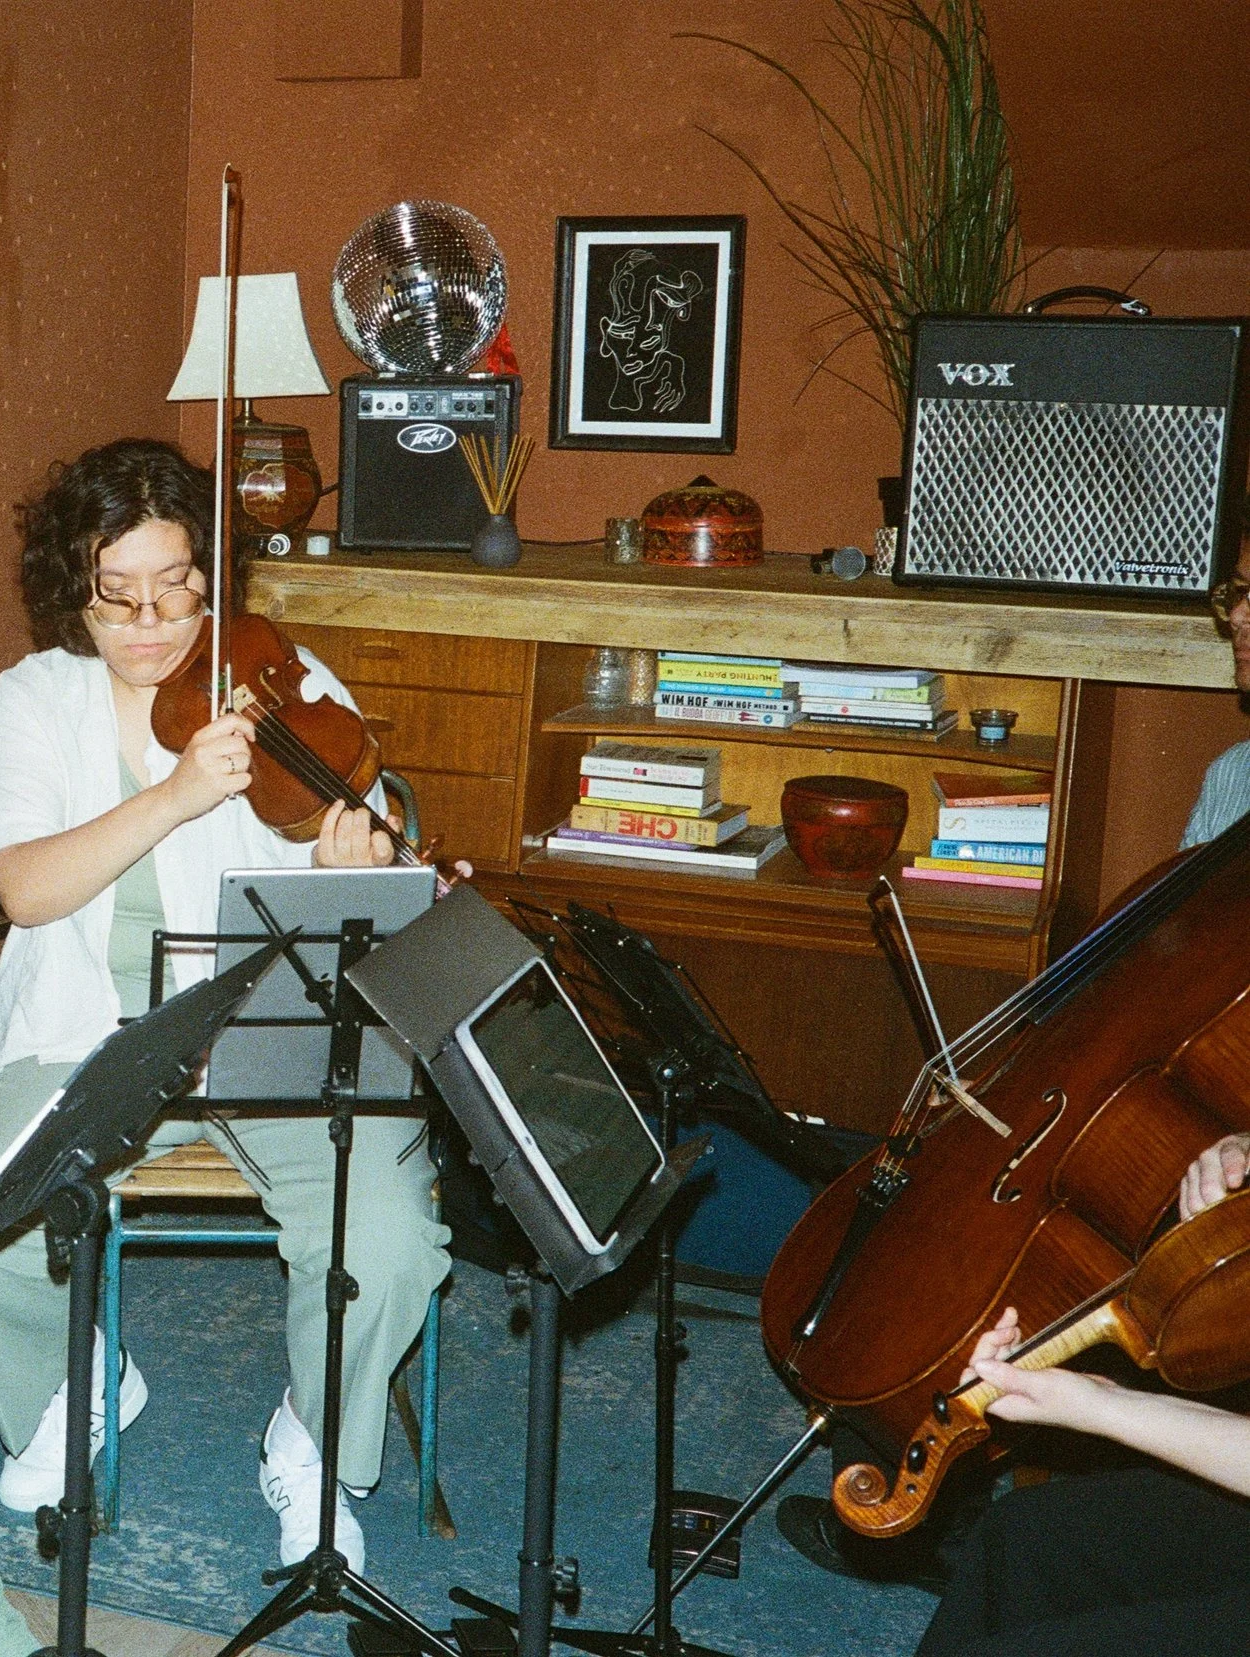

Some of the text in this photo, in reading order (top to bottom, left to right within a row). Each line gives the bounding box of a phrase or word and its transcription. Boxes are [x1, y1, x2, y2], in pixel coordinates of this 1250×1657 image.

[938, 363, 1015, 386] VOX
[1115, 561, 1189, 575] Valvetronix
[696, 670, 728, 679] PARTY
[729, 671, 772, 682] HUNTING
[661, 693, 684, 705] WIM
[687, 696, 709, 707] HOF
[716, 699, 734, 708] WIM
[736, 700, 752, 709] HOF
[617, 811, 678, 840] CHE
[976, 845, 1030, 863] AMERICAN
